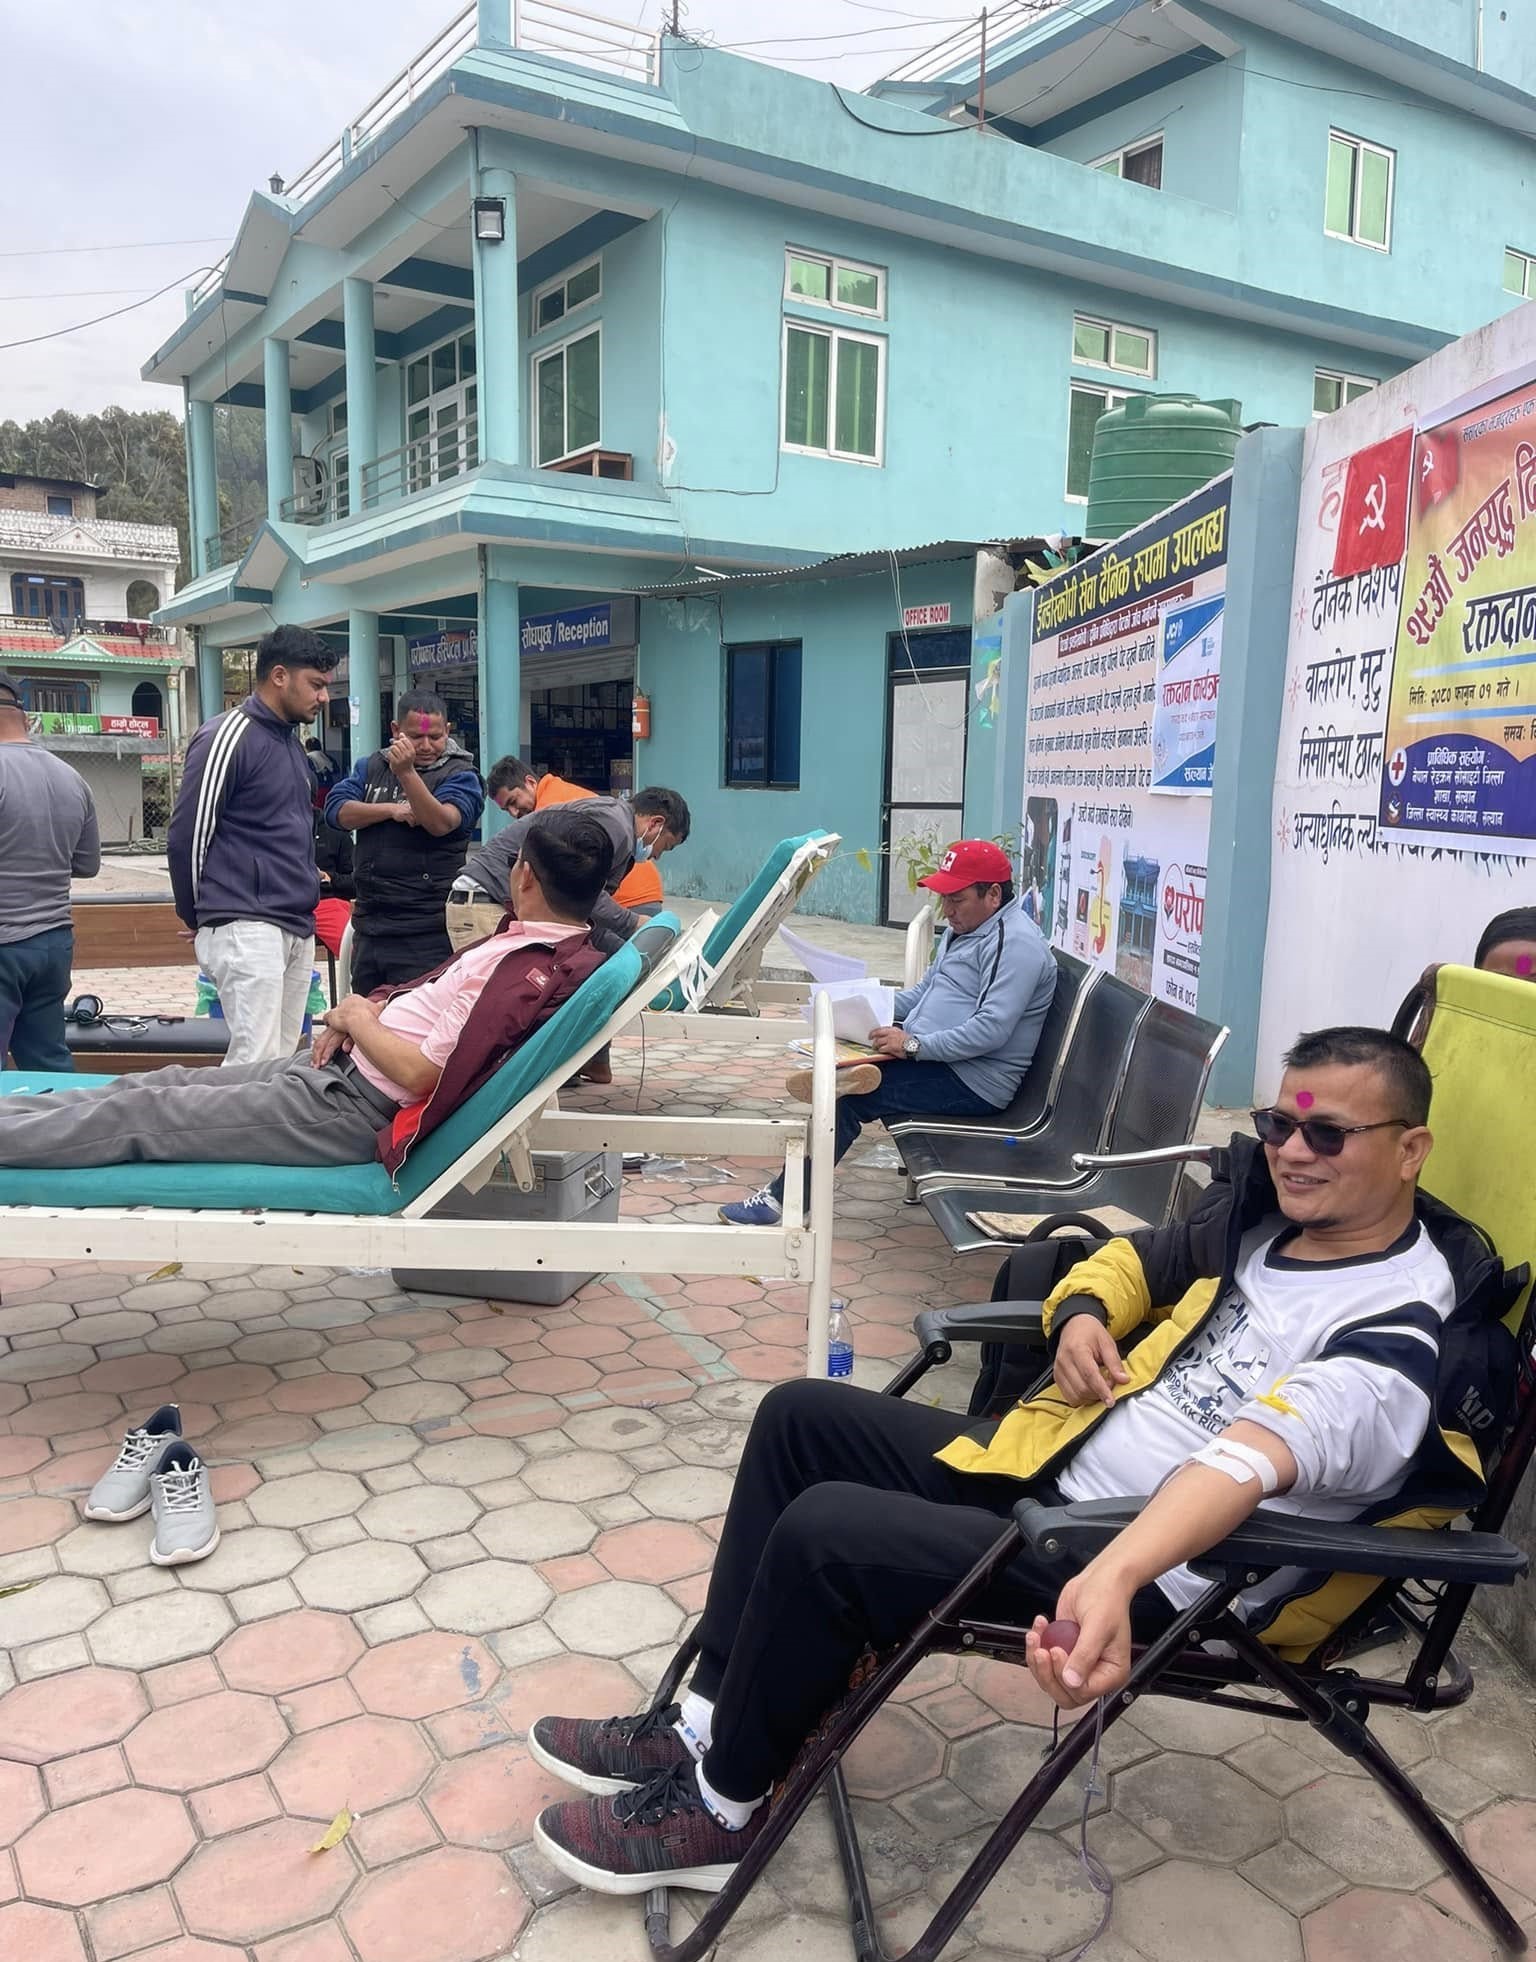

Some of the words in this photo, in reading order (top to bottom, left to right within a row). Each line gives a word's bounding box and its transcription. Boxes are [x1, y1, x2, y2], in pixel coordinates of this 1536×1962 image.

[1078, 568, 1098, 617] सेवा
[1099, 552, 1132, 607] दैनिक
[1171, 504, 1227, 574] उपलब्ध
[905, 607, 927, 626] OFFICE
[930, 605, 949, 623] ROOM
